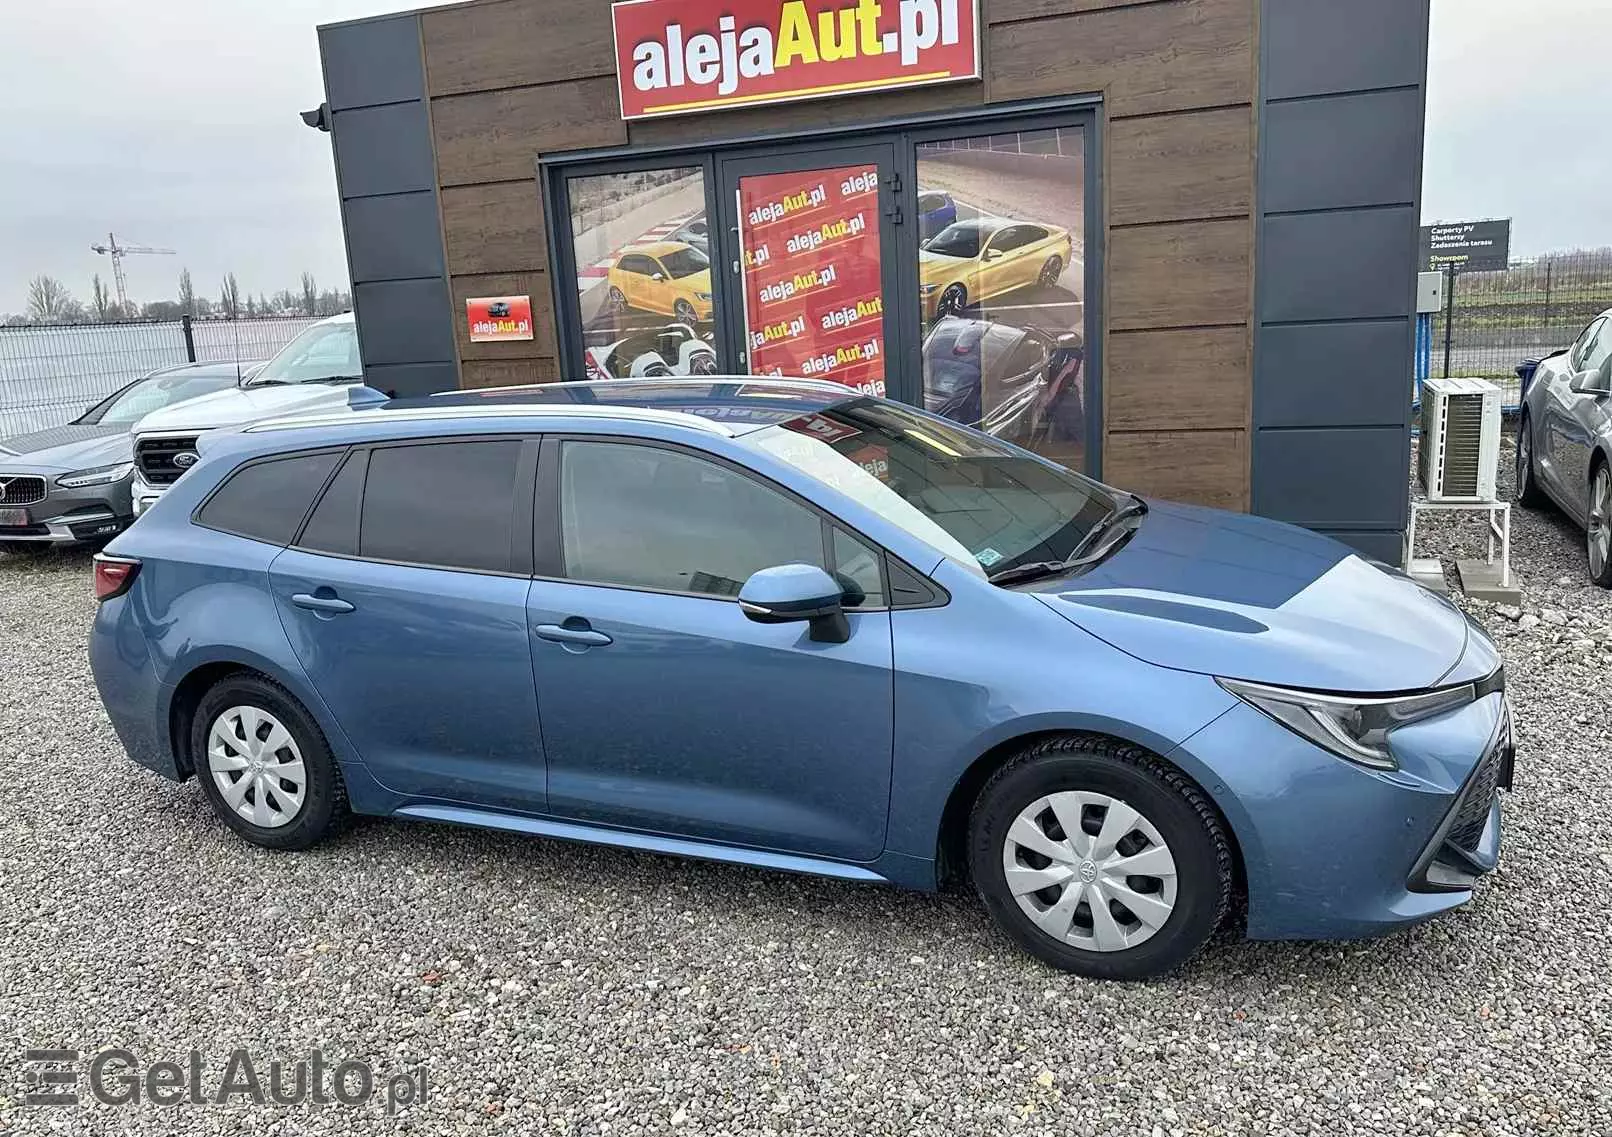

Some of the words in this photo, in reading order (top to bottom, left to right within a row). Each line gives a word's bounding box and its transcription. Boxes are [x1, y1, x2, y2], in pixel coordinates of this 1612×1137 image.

[633, 0, 959, 95] alejaAut.pl
[748, 184, 826, 226] alejaAut.pl
[786, 212, 865, 254] alejaAut.pl
[759, 264, 836, 303] alejaAut.pl
[473, 319, 529, 335] alejaAut.pl
[801, 339, 880, 375] alejaAut.pl
